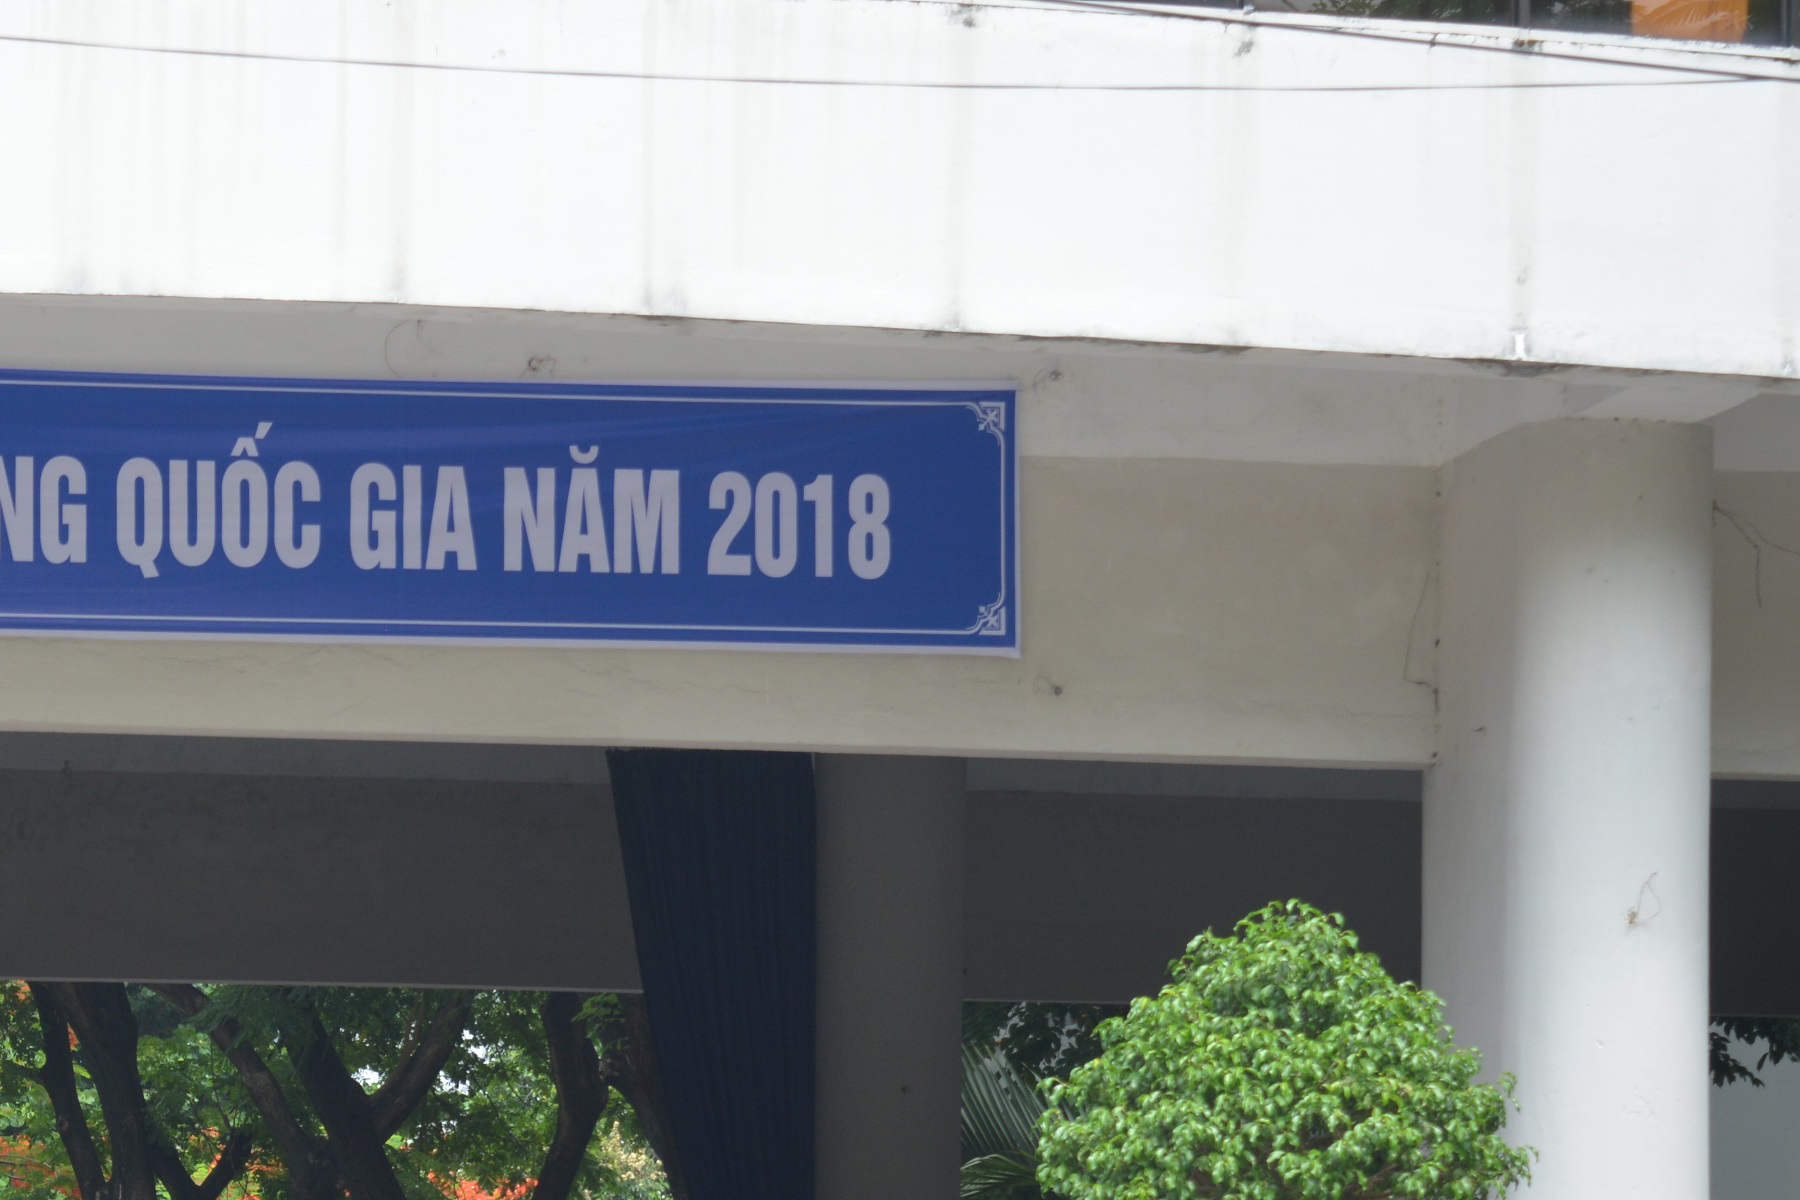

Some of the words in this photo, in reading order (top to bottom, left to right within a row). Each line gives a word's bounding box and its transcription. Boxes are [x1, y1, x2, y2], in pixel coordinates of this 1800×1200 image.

[116, 421, 321, 579] QUỐC
[349, 462, 477, 571] GIA
[503, 445, 680, 575] NĂM
[707, 471, 890, 580] 2018
